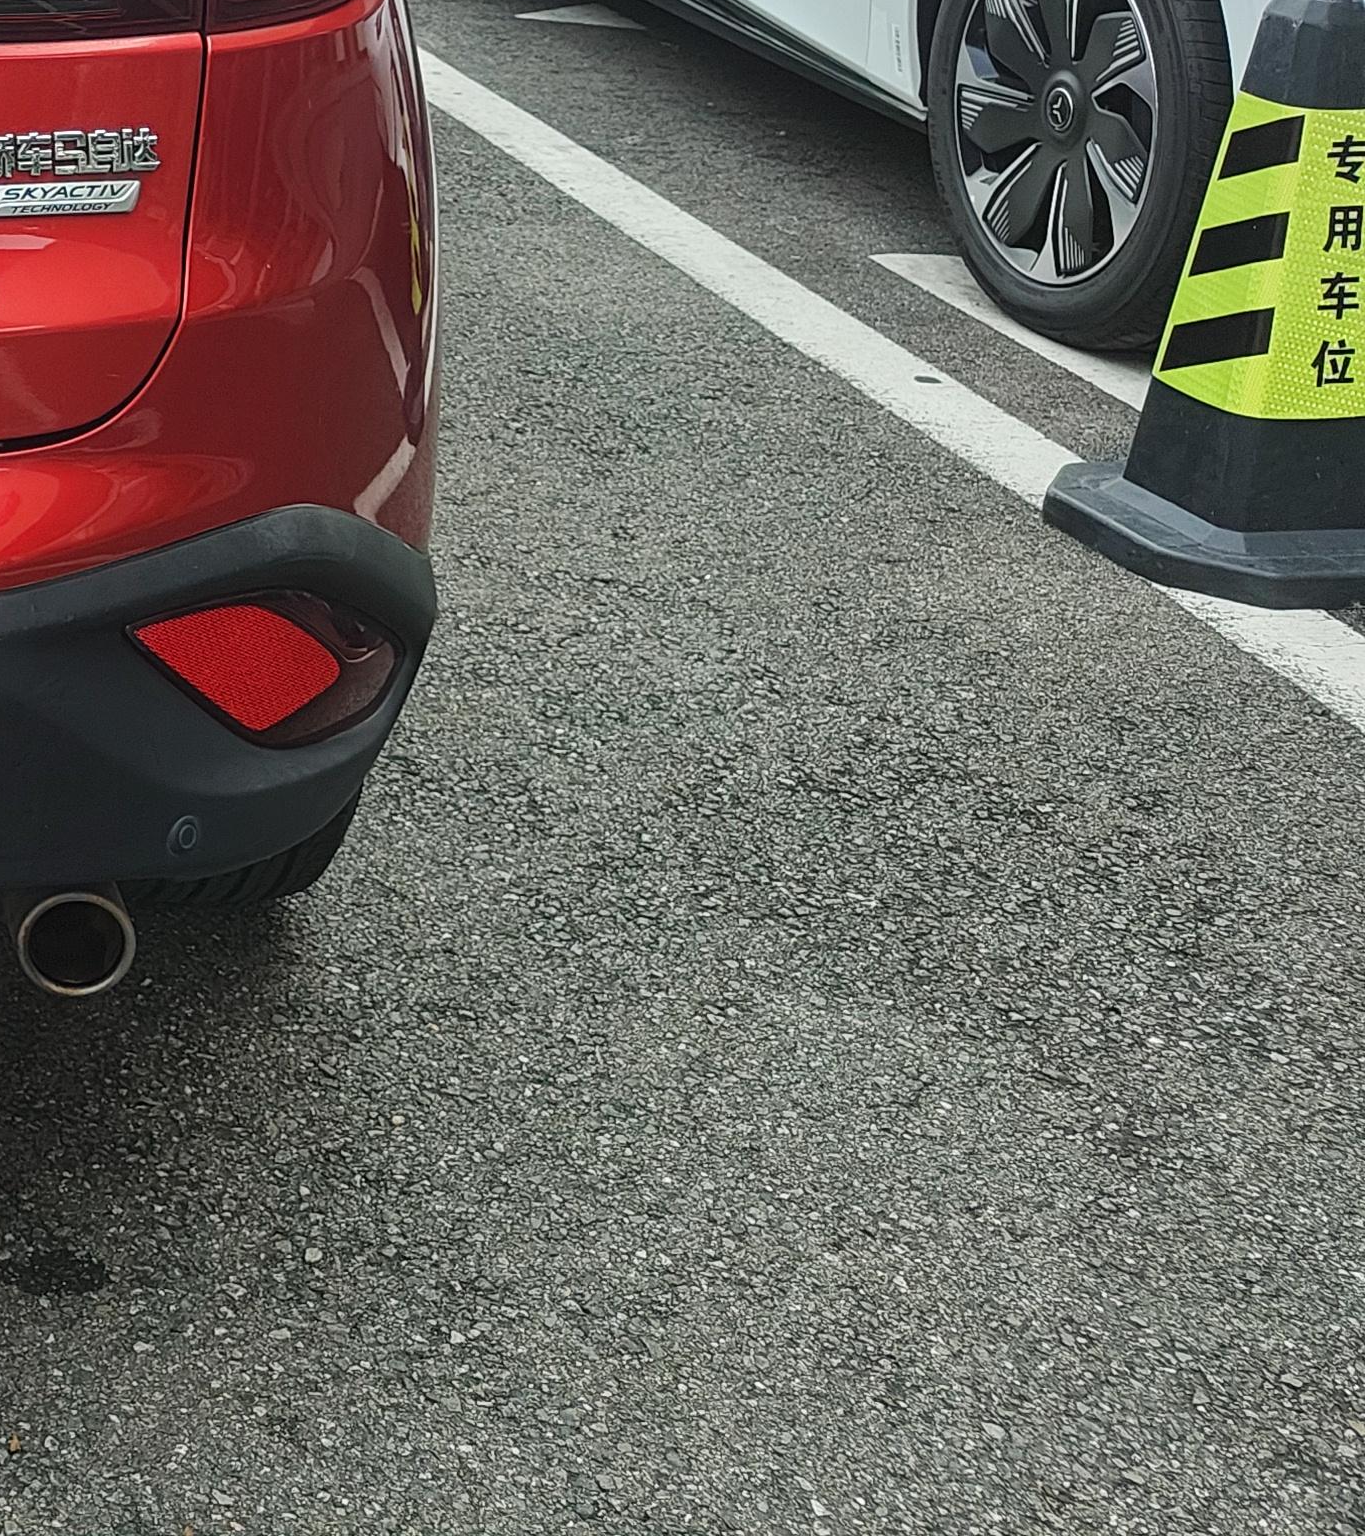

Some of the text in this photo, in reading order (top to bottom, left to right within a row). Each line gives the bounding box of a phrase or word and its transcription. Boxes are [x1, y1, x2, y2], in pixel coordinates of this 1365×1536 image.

[0, 182, 129, 201] SKYACTIV
[11, 201, 115, 215] TECHNOLOGY
[1310, 134, 1365, 388] 专用车位
